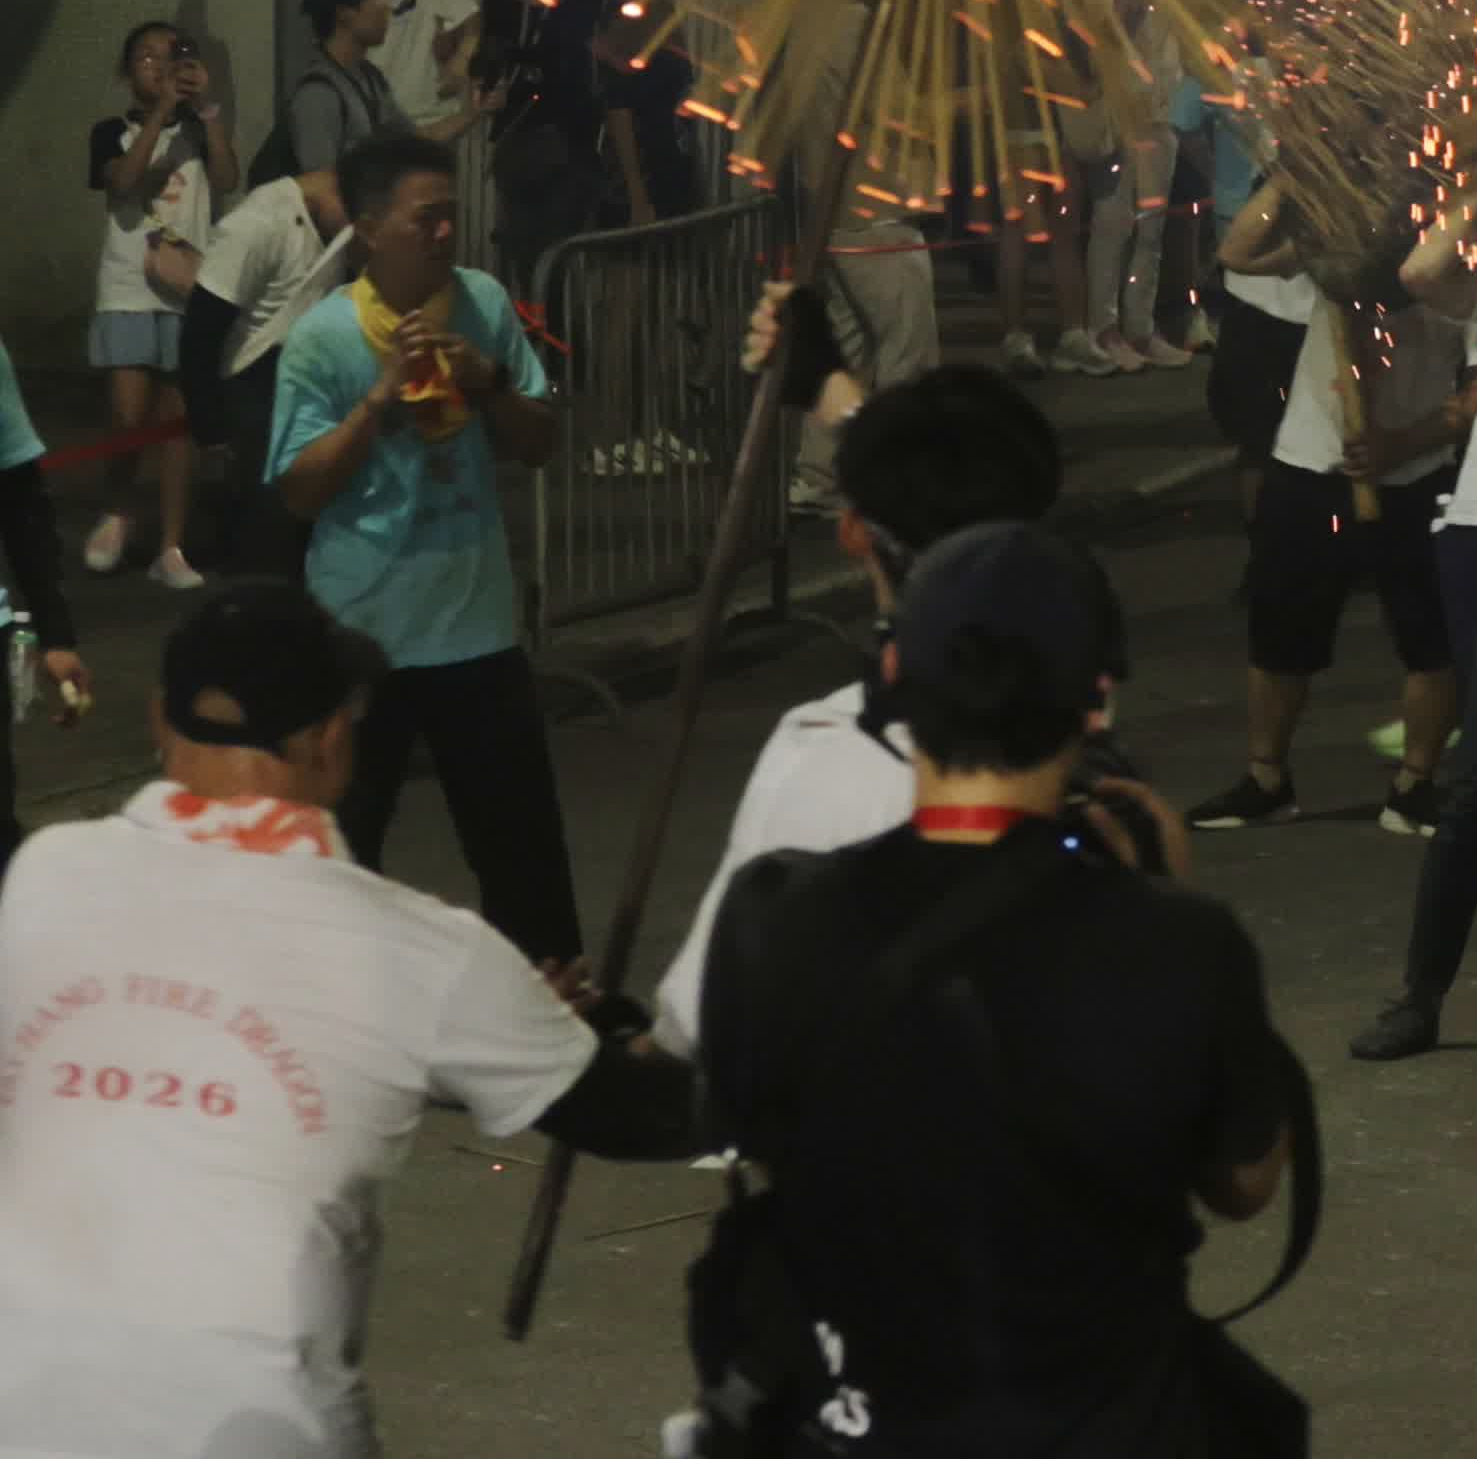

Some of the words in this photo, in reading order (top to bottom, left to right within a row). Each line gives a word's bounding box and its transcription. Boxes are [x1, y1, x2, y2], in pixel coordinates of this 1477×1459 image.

[14, 974, 106, 1052] HANG
[121, 973, 220, 1020] FIRE
[224, 1006, 328, 1136] DRAGON
[50, 1061, 238, 1119] 2026
